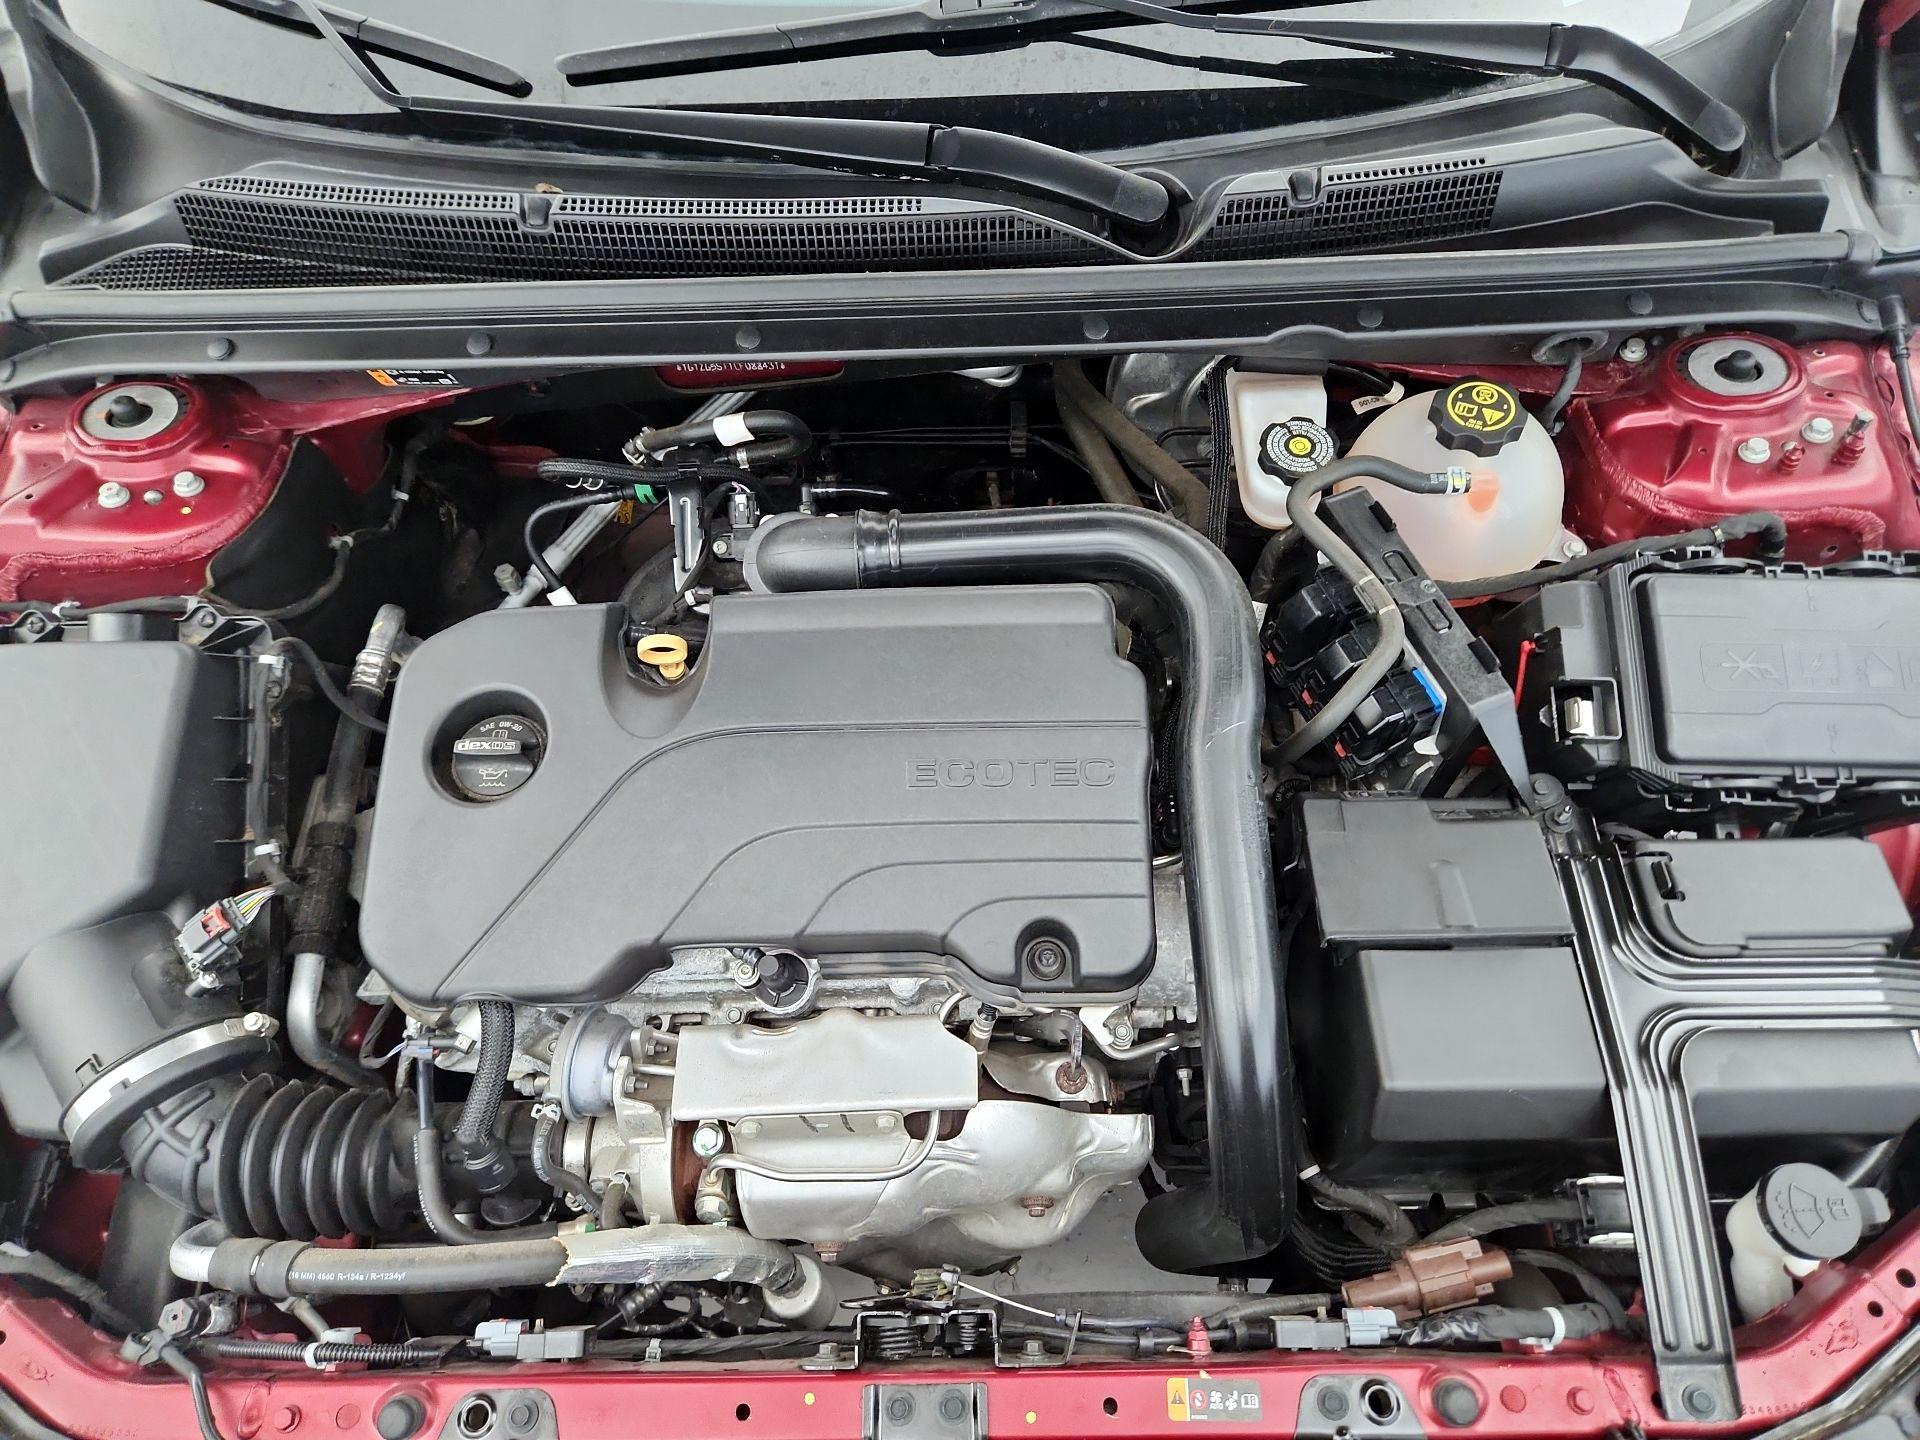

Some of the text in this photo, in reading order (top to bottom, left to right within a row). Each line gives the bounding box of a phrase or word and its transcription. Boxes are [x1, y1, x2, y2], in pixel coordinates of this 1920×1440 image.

[480, 721, 523, 733] SAE 0W-20
[457, 741, 517, 751] dexos
[906, 758, 1116, 788] ECOTEC
[337, 1272, 364, 1281] R-134a
[370, 1271, 407, 1282] R-1234yf
